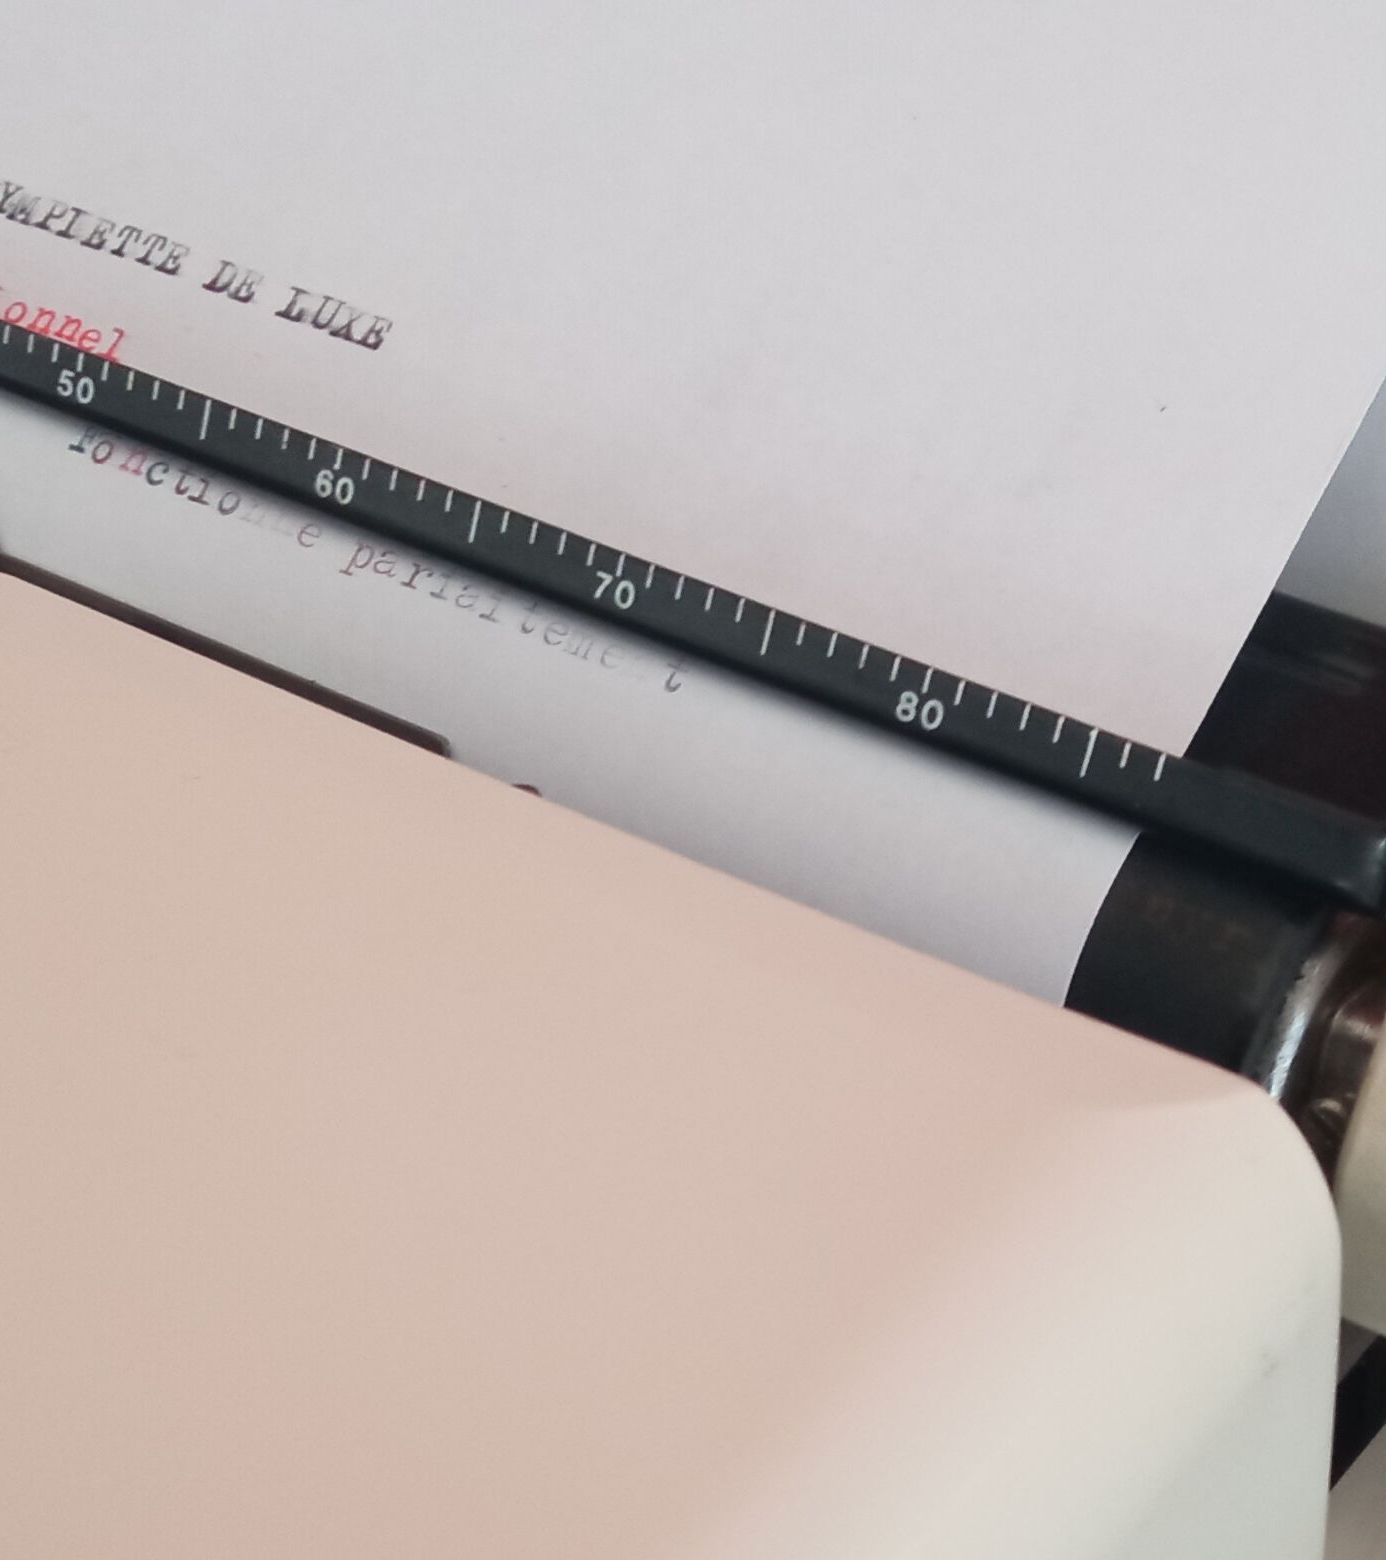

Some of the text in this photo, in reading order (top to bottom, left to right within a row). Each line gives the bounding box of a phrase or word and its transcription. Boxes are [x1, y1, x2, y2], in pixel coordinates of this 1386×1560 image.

[202, 259, 266, 304] DE
[275, 286, 393, 351] LUXE
[56, 369, 95, 405] 50
[315, 469, 355, 505] 60
[593, 569, 636, 610] 70
[894, 690, 945, 733] 80
